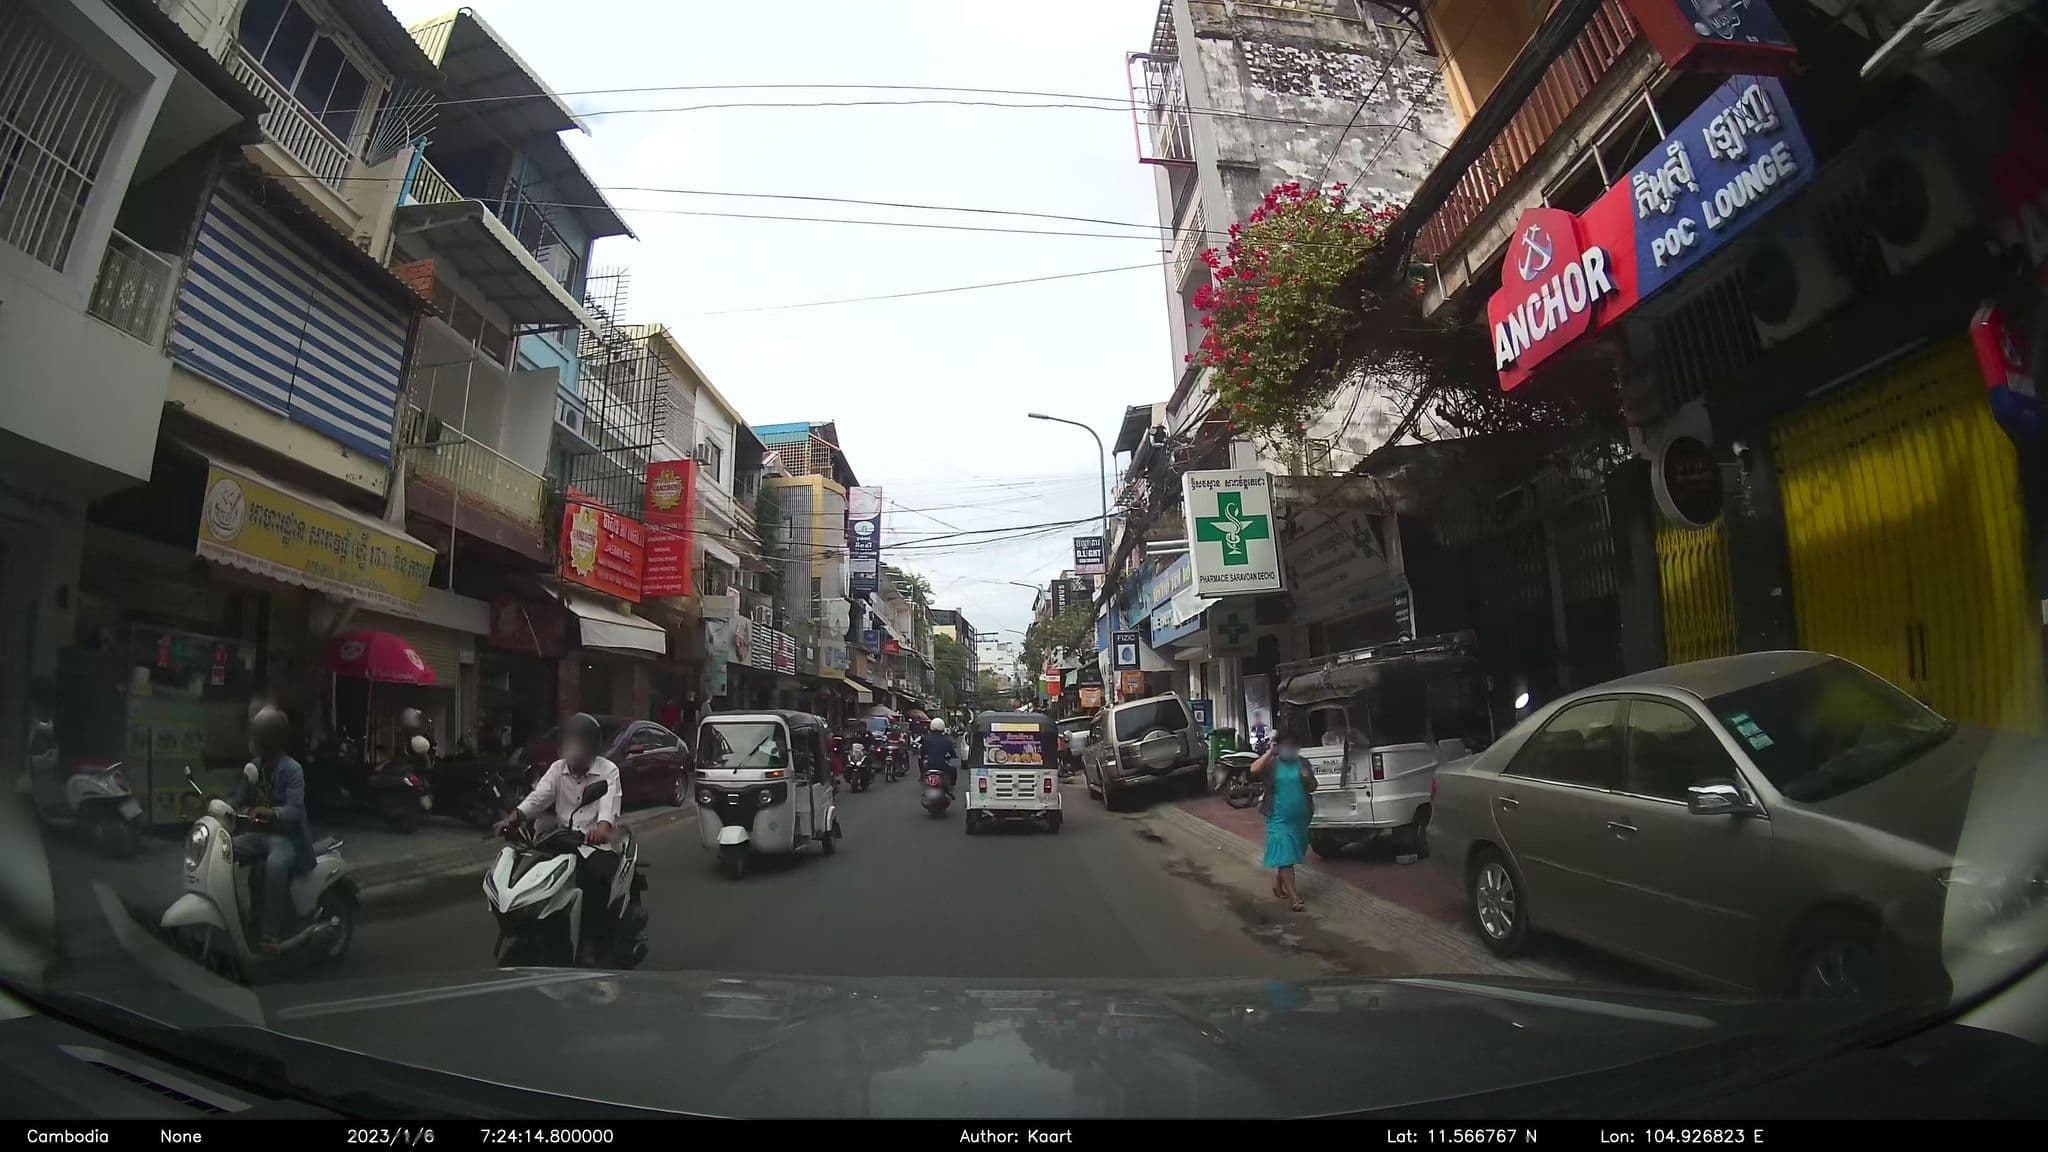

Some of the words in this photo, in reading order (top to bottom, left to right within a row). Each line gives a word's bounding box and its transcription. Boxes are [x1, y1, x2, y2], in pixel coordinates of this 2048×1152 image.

[1651, 217, 1698, 268] POC
[1701, 140, 1798, 231] LOUNGE
[1495, 245, 1614, 371] ANCHOR
[1199, 574, 1229, 584] PHARMACIE
[1229, 571, 1258, 583] SARAVOAN
[1257, 570, 1276, 580] DECHO
